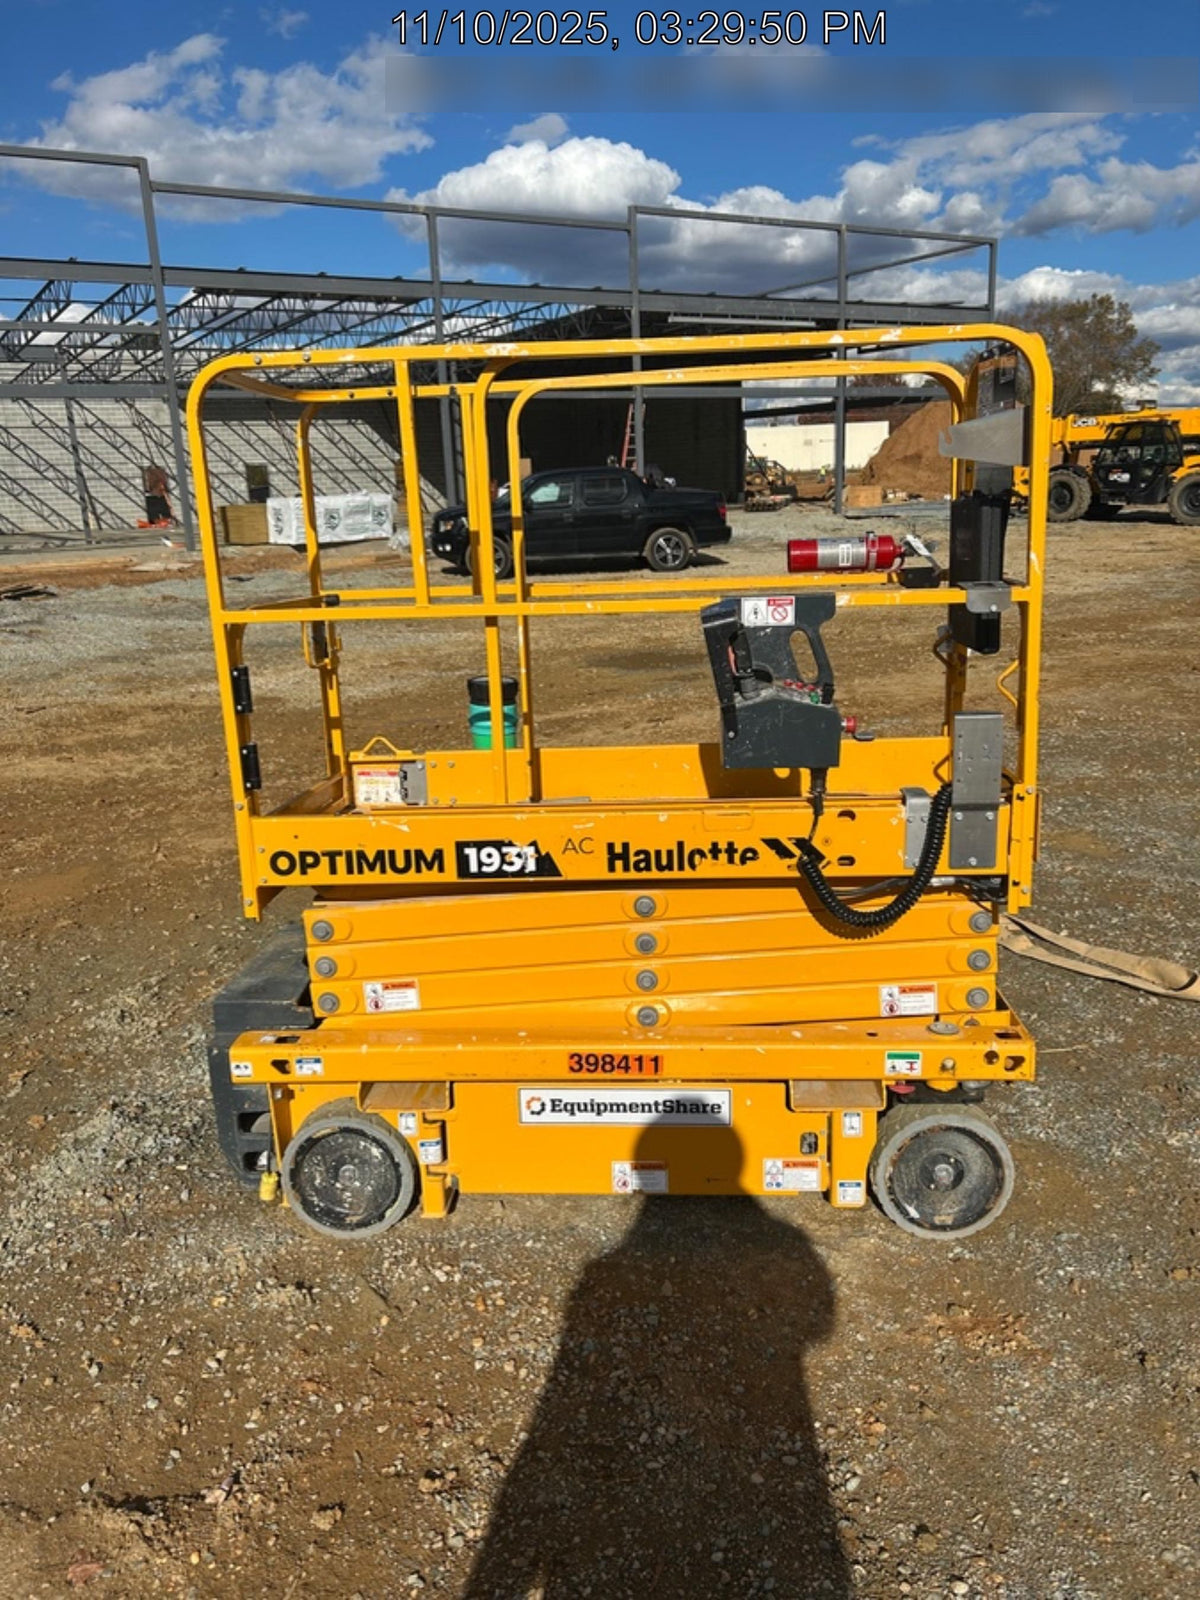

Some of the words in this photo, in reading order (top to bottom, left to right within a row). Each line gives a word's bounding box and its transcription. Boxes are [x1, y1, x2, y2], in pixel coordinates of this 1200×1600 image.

[269, 848, 445, 876] OPTIMUM
[463, 845, 538, 874] 1931
[562, 837, 595, 855] AC
[568, 1053, 661, 1075] 398411
[550, 1098, 722, 1116] EquipmentShare
